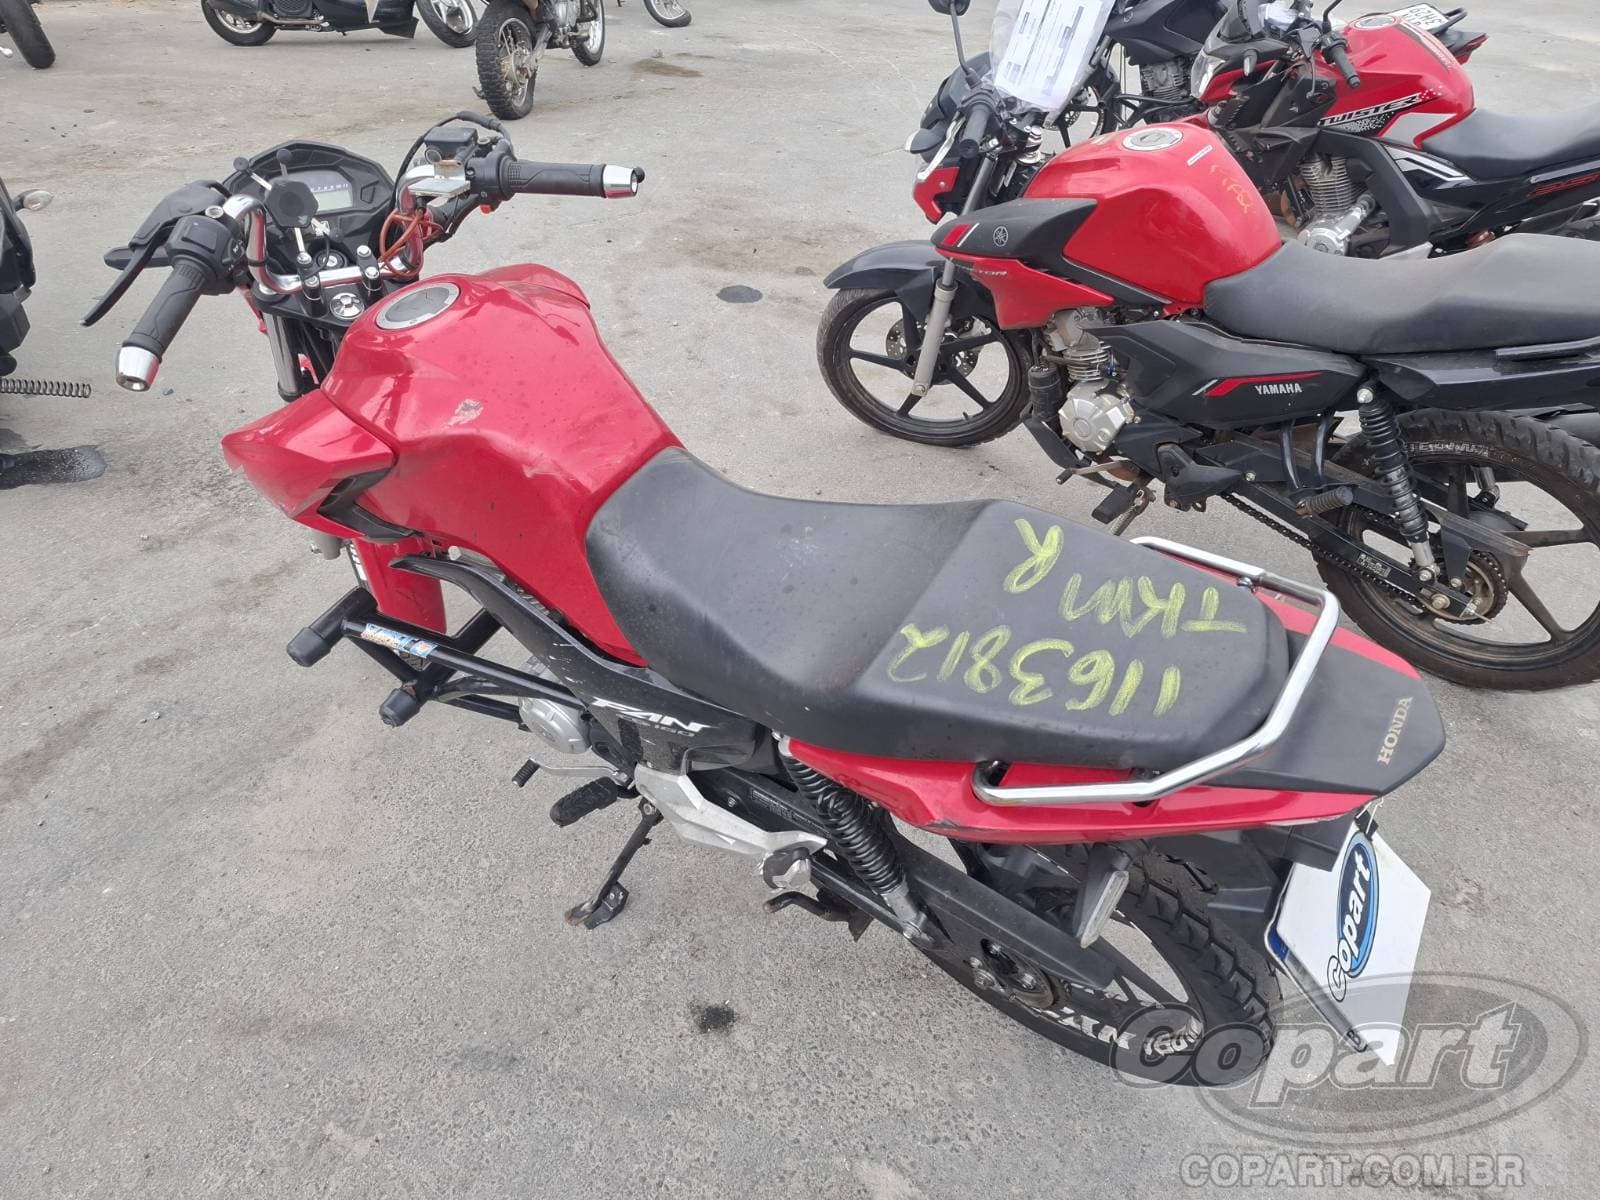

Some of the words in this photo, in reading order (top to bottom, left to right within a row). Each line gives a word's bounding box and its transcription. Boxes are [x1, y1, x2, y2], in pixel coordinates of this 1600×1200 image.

[1318, 94, 1420, 127] TWISTER
[1254, 383, 1303, 395] YAMAHA
[1003, 517, 1065, 594] R
[886, 622, 1181, 717] 1163812
[592, 696, 717, 733] FAN
[1377, 696, 1413, 765] HONDA
[1326, 850, 1372, 1003] Copart
